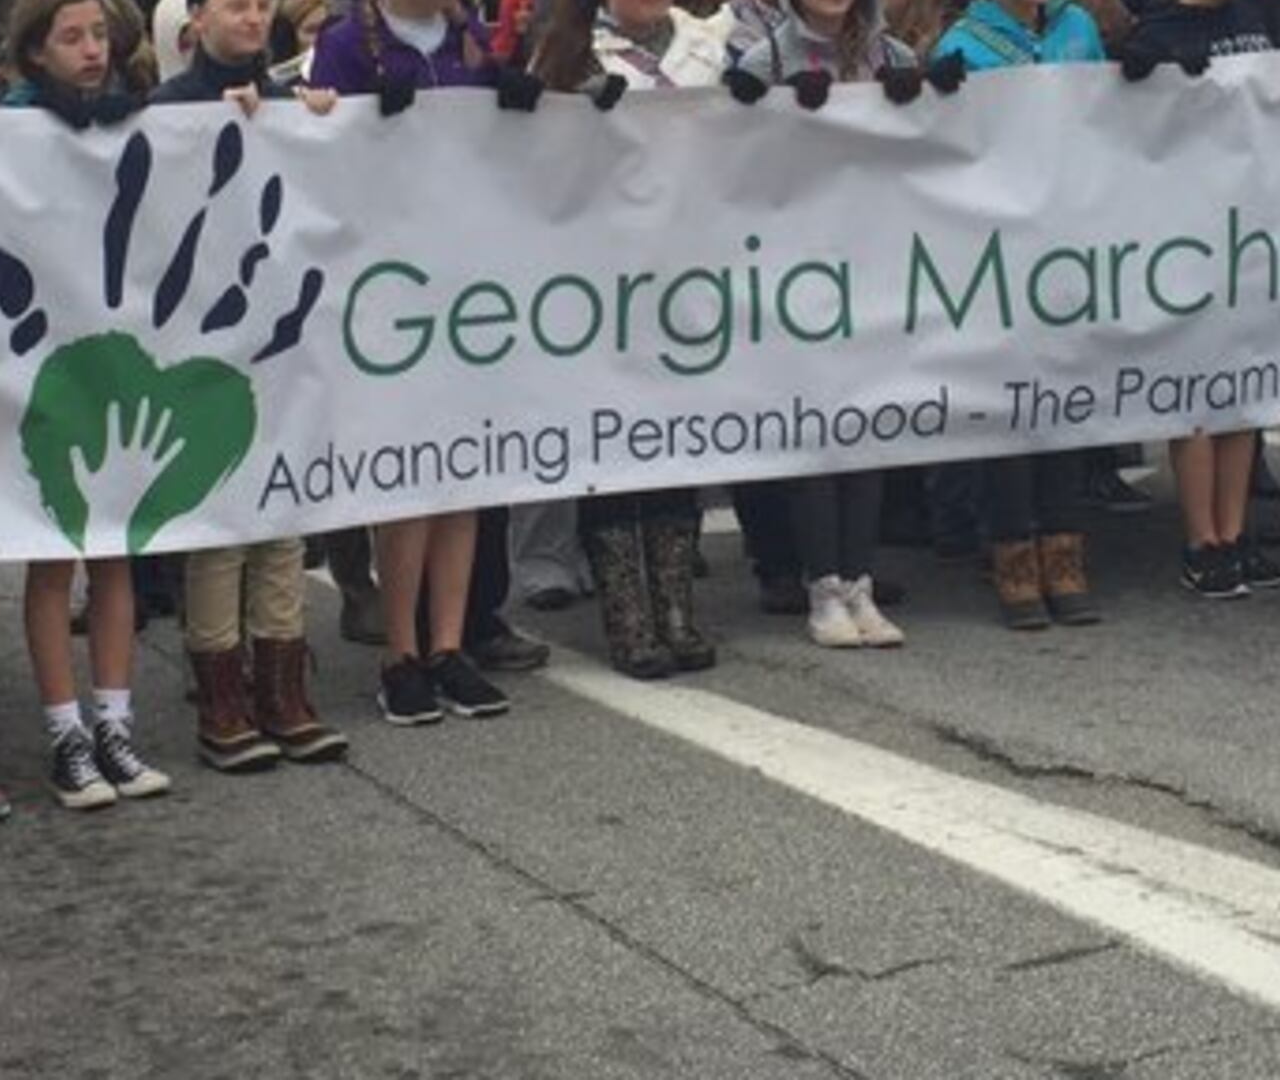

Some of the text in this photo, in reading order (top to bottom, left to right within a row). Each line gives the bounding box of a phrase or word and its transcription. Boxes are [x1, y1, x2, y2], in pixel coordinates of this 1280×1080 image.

[342, 235, 852, 376] Georgia
[903, 206, 1278, 335] March
[258, 419, 570, 510] Advancing
[592, 386, 949, 464] Personhood
[1004, 379, 1097, 431] The
